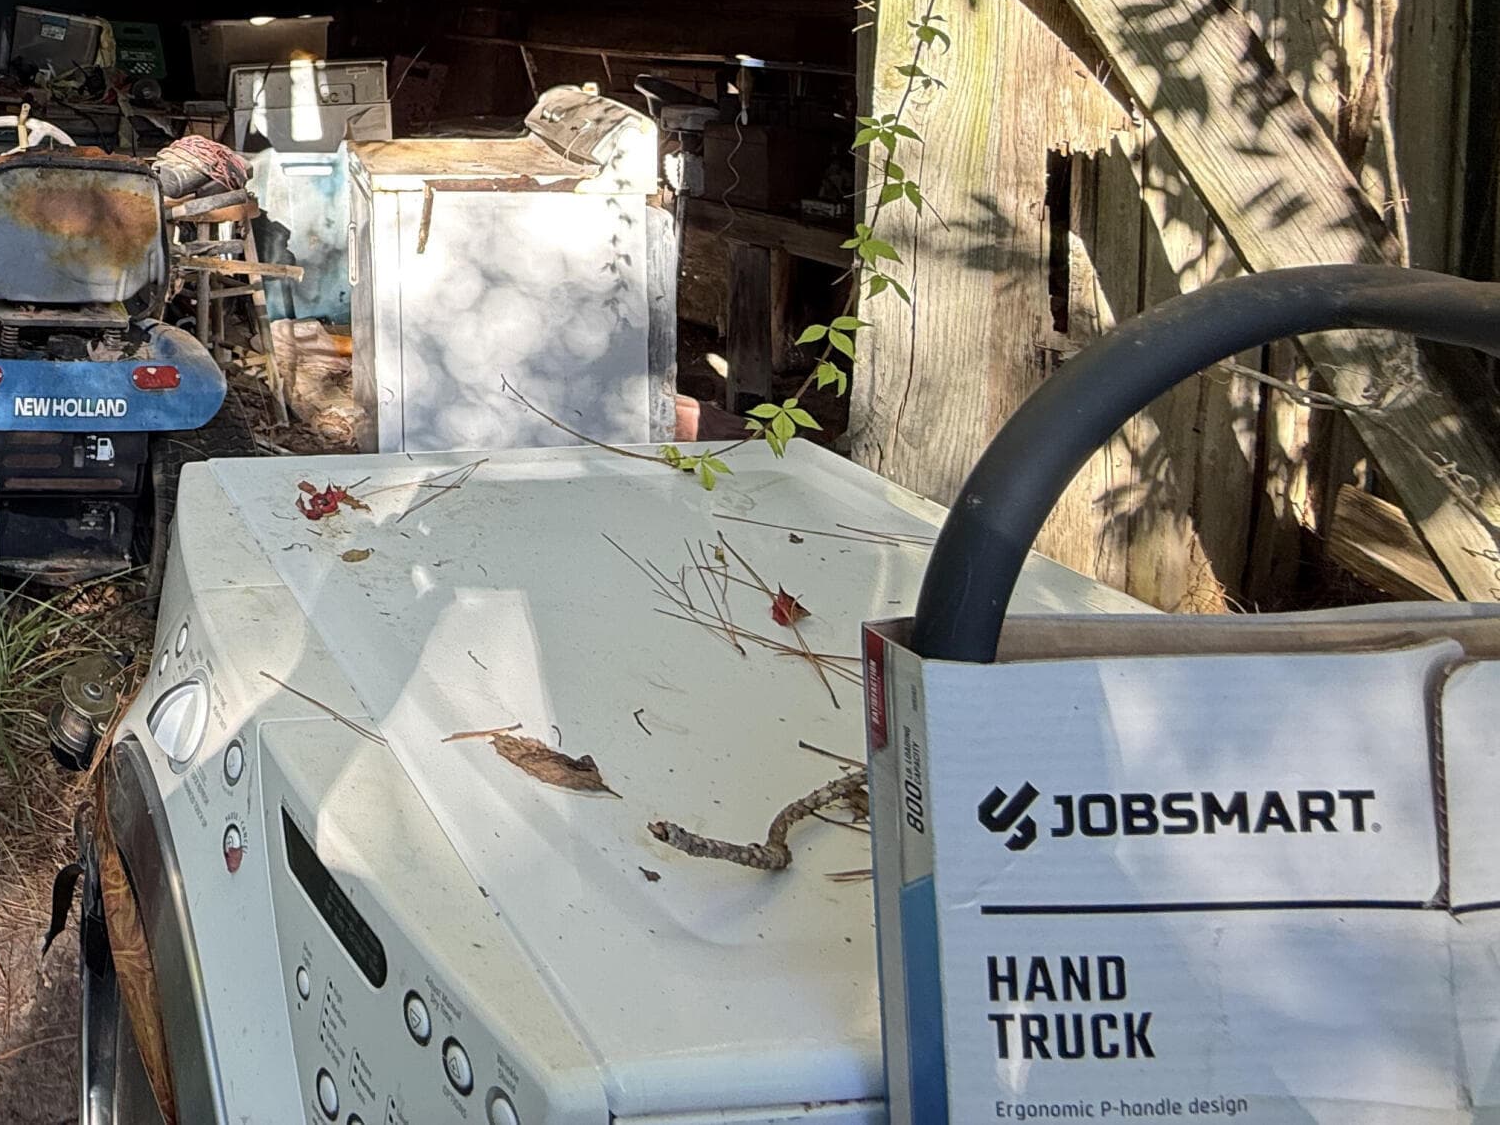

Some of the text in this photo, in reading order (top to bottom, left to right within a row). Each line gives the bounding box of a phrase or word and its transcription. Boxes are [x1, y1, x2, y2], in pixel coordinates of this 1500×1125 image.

[14, 396, 128, 418] NEW HOLLAND
[911, 740, 923, 785] CAPACITY
[904, 779, 925, 835] 800
[1051, 789, 1376, 839] JOBSMART
[987, 955, 1127, 1003] HAND
[987, 1012, 1156, 1061] TRUCK
[995, 1095, 1248, 1121] Ergonomic P-handle design
